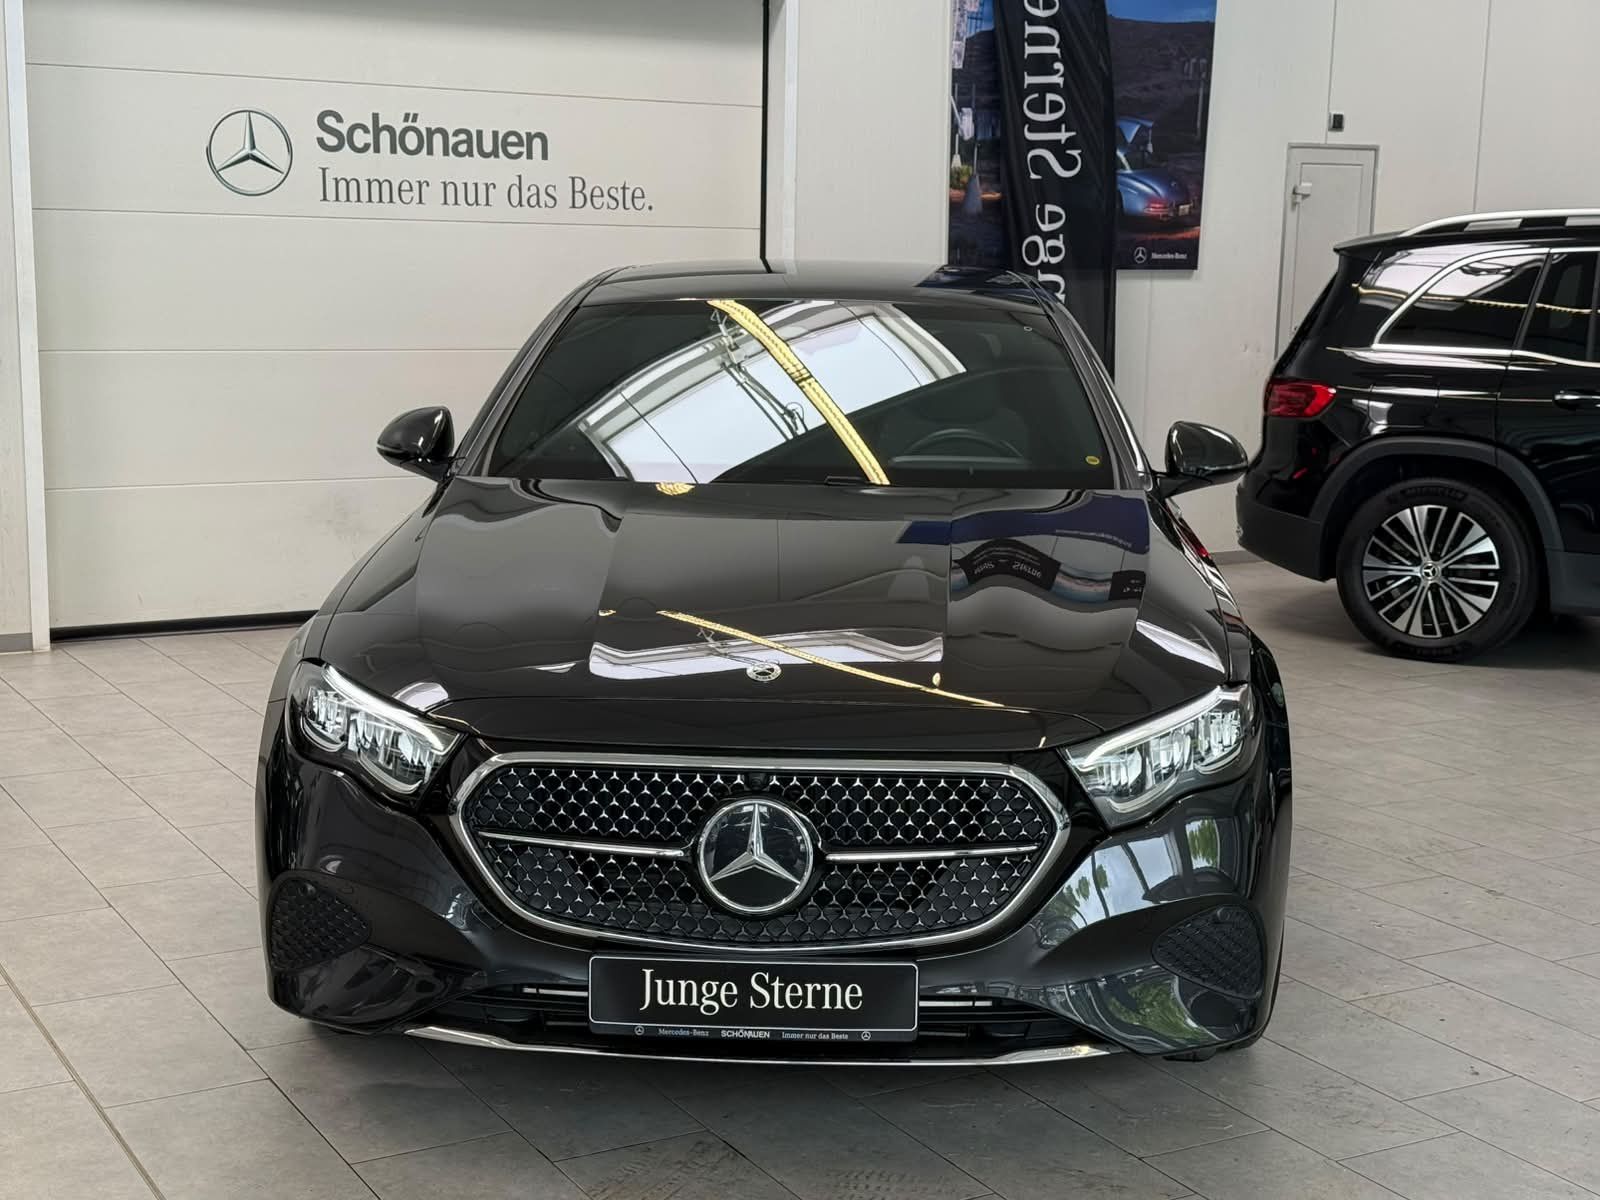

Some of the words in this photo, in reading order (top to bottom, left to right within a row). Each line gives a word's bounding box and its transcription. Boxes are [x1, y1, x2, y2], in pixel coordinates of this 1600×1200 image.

[316, 109, 549, 161] Schönauen
[319, 167, 430, 206] Immer
[440, 180, 496, 207] nur
[507, 175, 558, 209] das
[568, 176, 654, 212] Beste.
[640, 968, 738, 1015] Junge
[750, 972, 863, 1010] Sterne
[658, 1028, 709, 1037] Mercedes-Benz
[721, 1028, 770, 1039] SCHÖNAUEN
[782, 1031, 804, 1039] Immer
[818, 1032, 829, 1040] das
[831, 1032, 849, 1040] Beste
